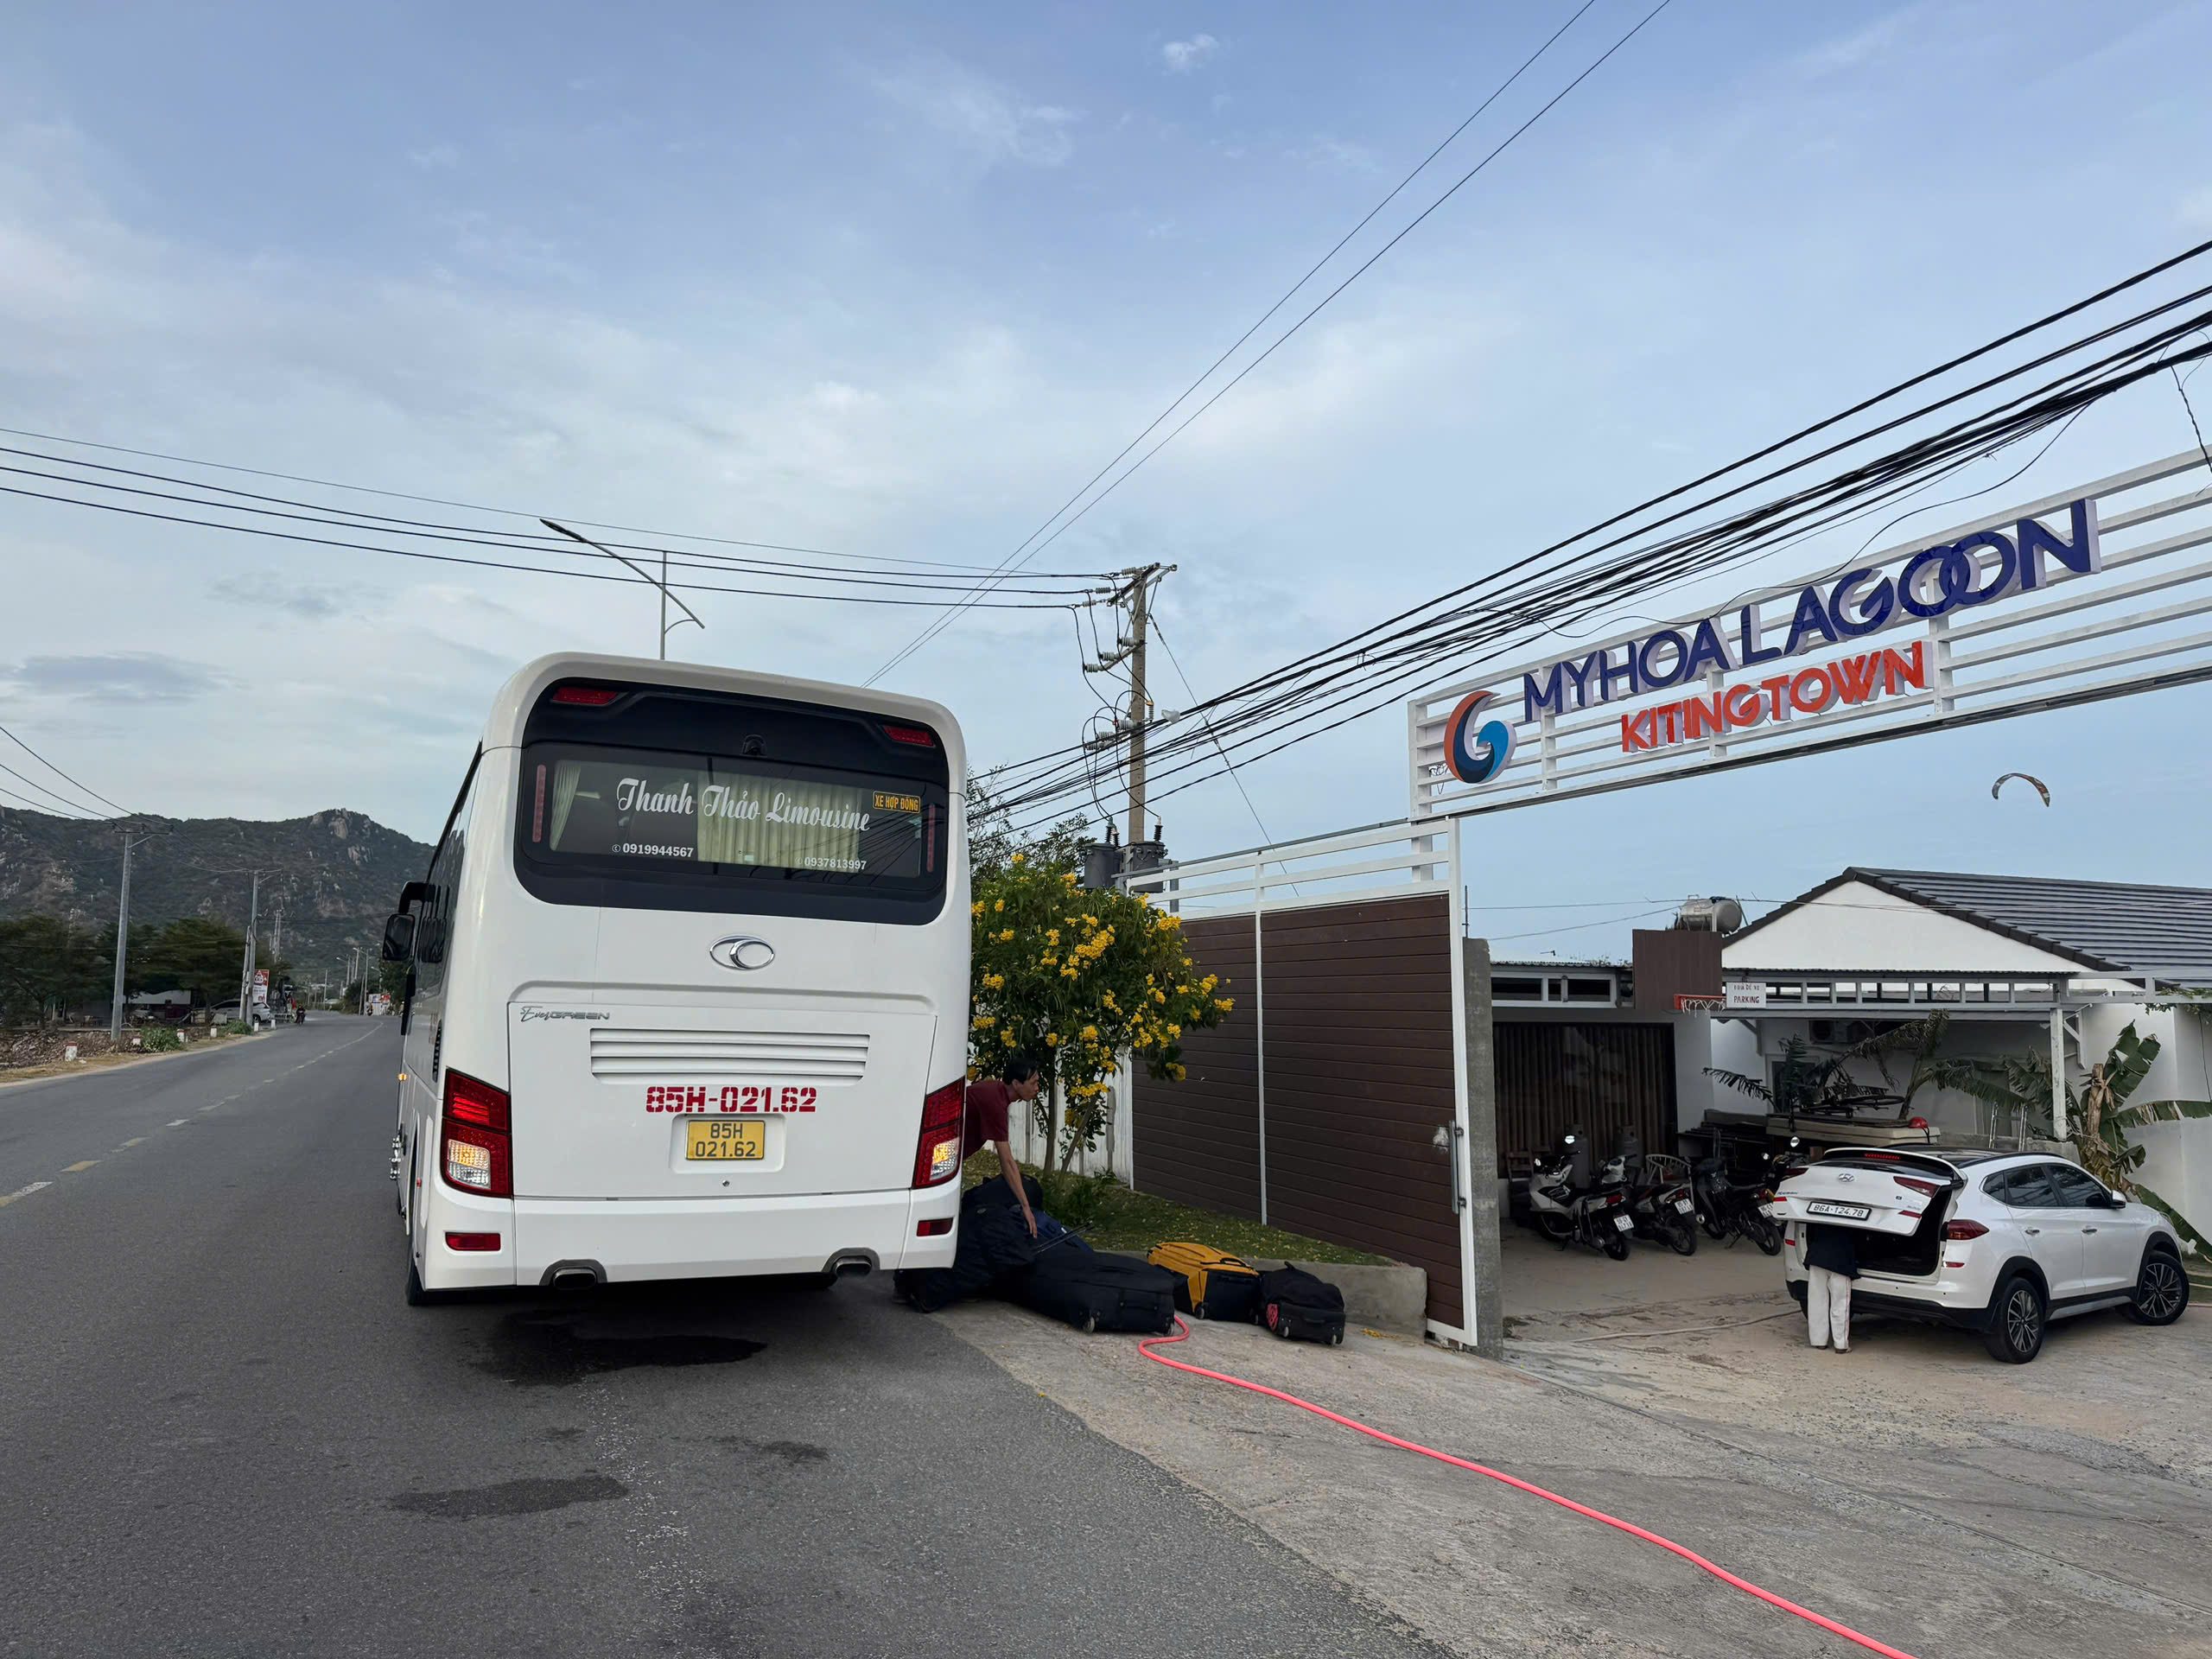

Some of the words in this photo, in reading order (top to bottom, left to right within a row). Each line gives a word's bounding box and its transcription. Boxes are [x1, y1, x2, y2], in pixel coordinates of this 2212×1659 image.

[616, 778, 694, 815] Thanh
[702, 785, 761, 820] Thảo
[766, 791, 870, 831] Limousine
[874, 794, 884, 807] XE
[622, 842, 695, 858] 0919944567
[804, 856, 868, 871] 0937813997
[1733, 995, 1759, 1004] PARKING
[645, 1086, 817, 1113] 85H-021.62
[710, 1122, 743, 1139] 85H
[695, 1141, 756, 1158] 021.62
